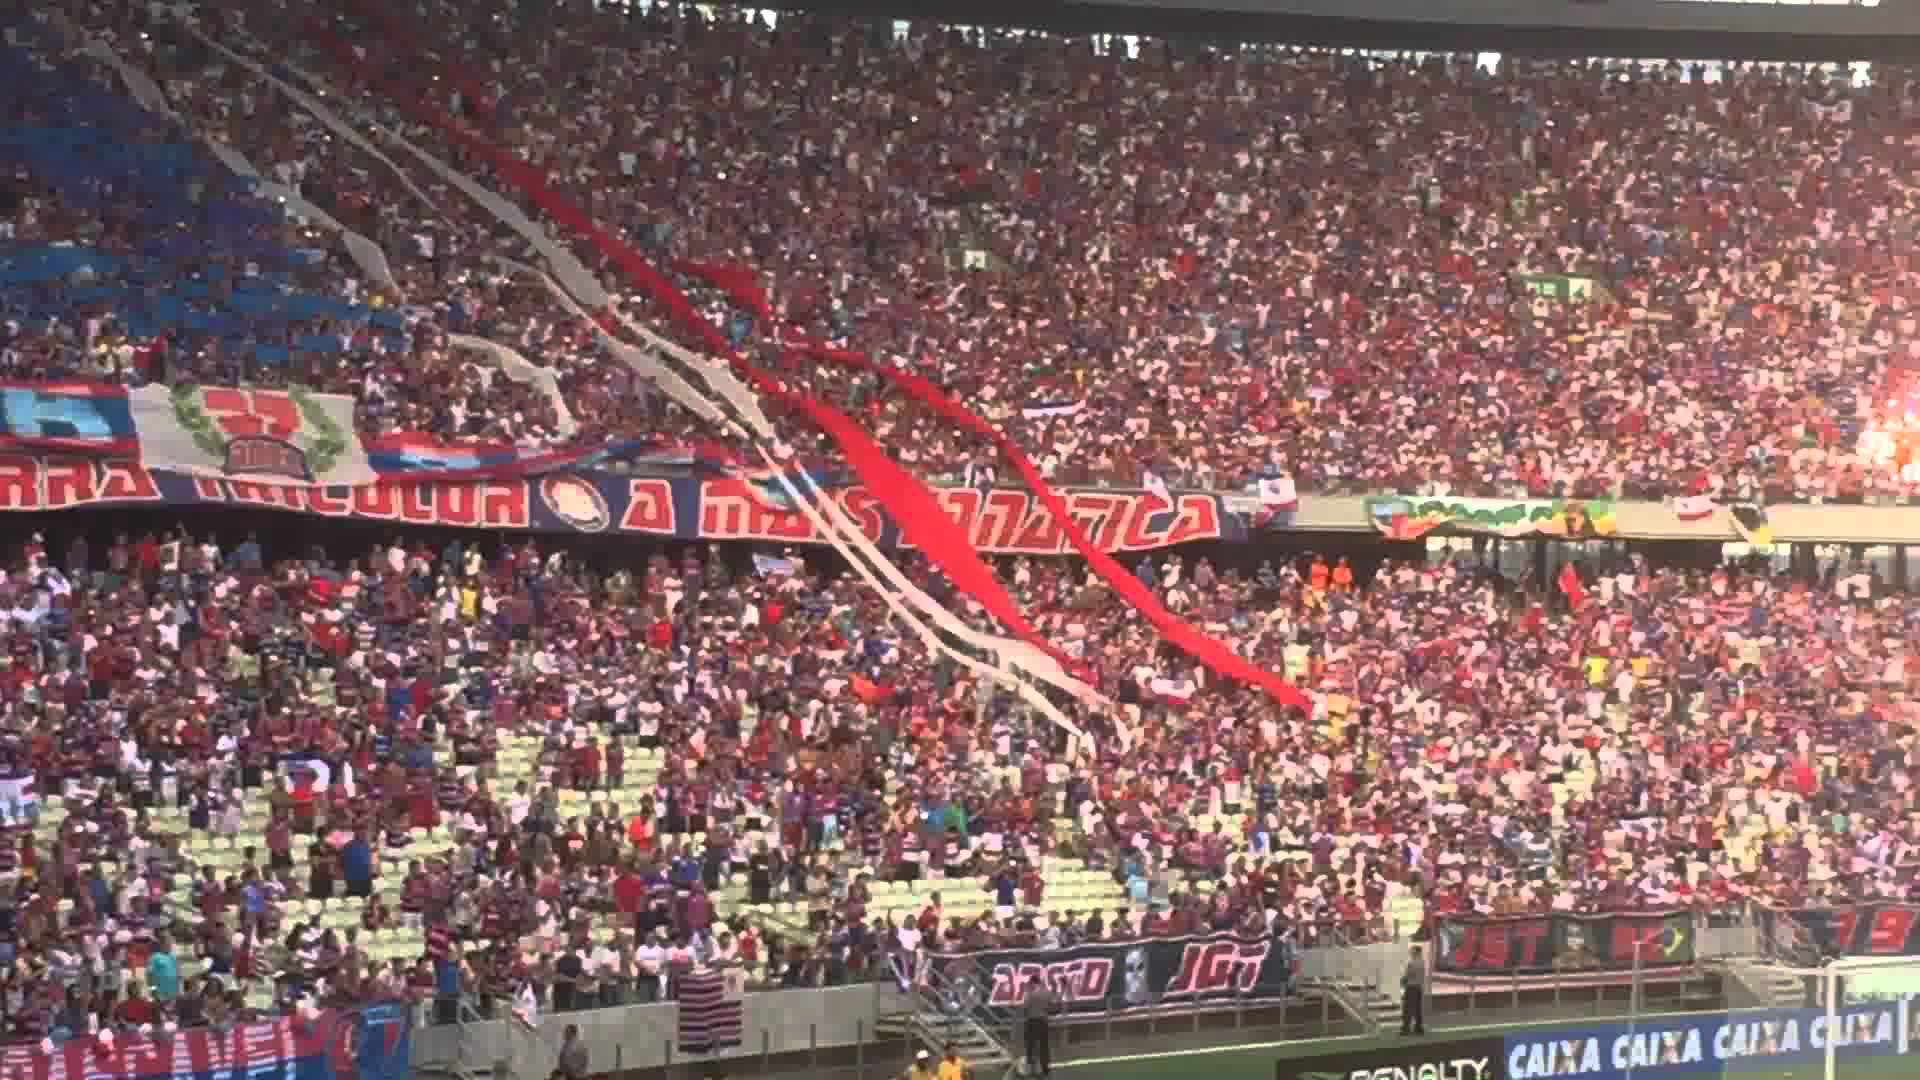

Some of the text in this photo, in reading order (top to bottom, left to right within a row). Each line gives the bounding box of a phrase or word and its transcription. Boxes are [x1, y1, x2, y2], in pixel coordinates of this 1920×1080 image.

[619, 479, 676, 534] A
[1508, 1037, 1601, 1080] CAIXA
[1611, 1027, 1704, 1070] CAIXA
[1713, 1019, 1801, 1060] CAIXA
